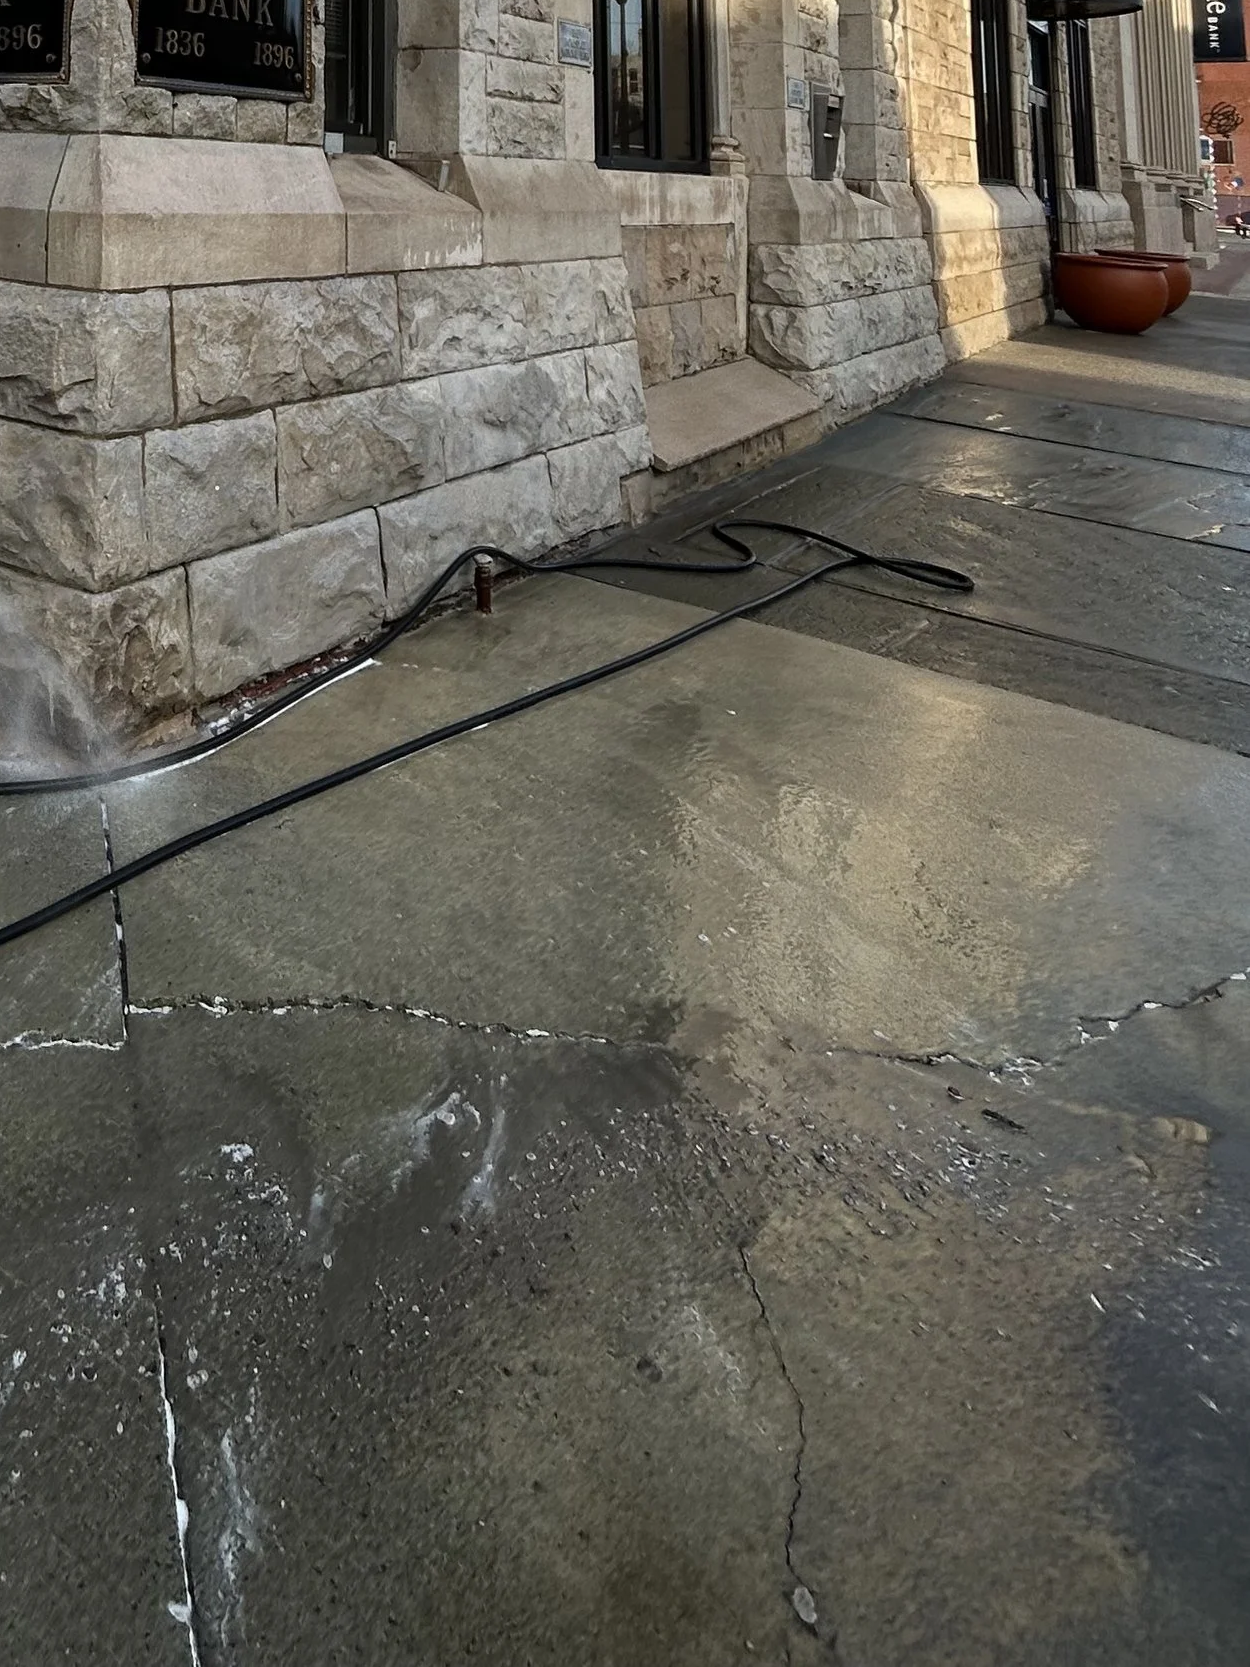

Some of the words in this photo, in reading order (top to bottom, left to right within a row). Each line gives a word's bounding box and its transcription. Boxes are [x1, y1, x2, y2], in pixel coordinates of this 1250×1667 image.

[155, 27, 206, 57] 1836
[254, 41, 294, 69] 1896
[1208, 17, 1219, 49] BANK
